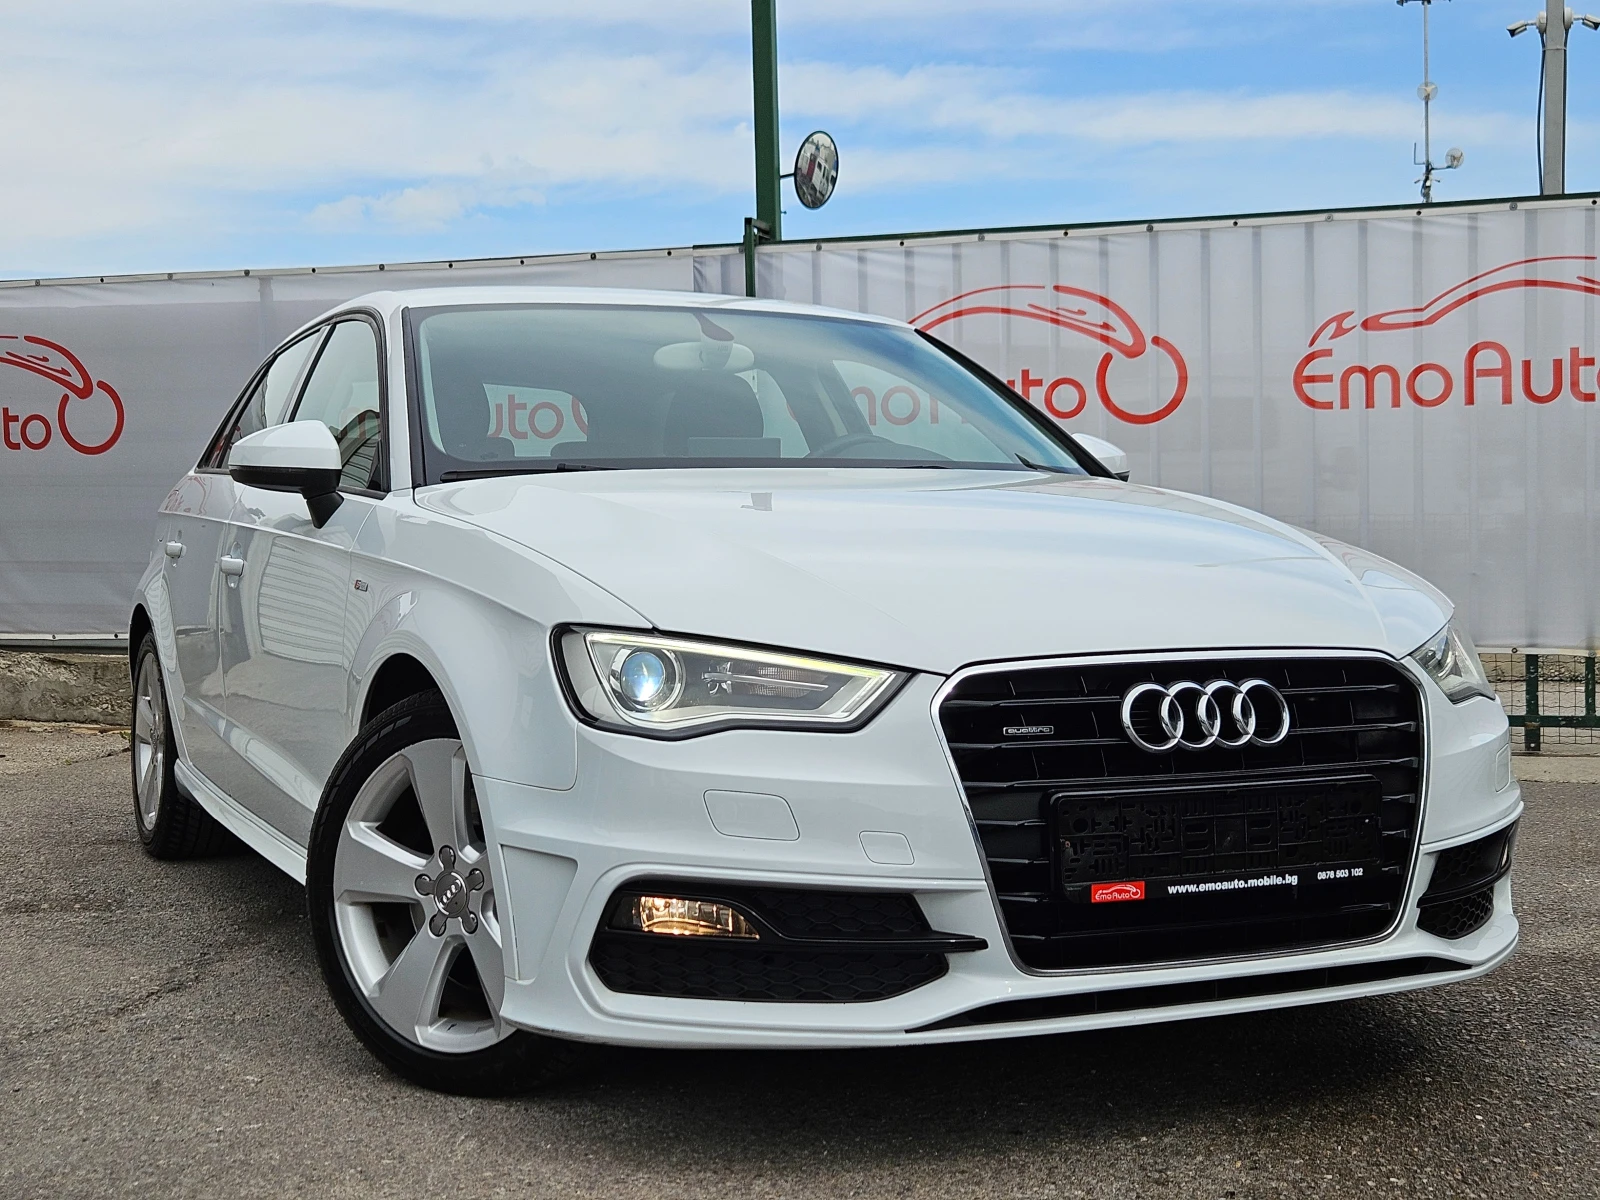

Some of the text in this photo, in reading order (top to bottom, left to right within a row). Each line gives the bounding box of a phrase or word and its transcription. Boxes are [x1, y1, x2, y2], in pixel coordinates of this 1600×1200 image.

[1293, 341, 1600, 410] EmoAut
[1007, 368, 1087, 419] to
[1007, 727, 1050, 735] quattro
[1167, 874, 1298, 894] www.emoauto.mobile.bg
[1317, 868, 1364, 880] 0878 503 102
